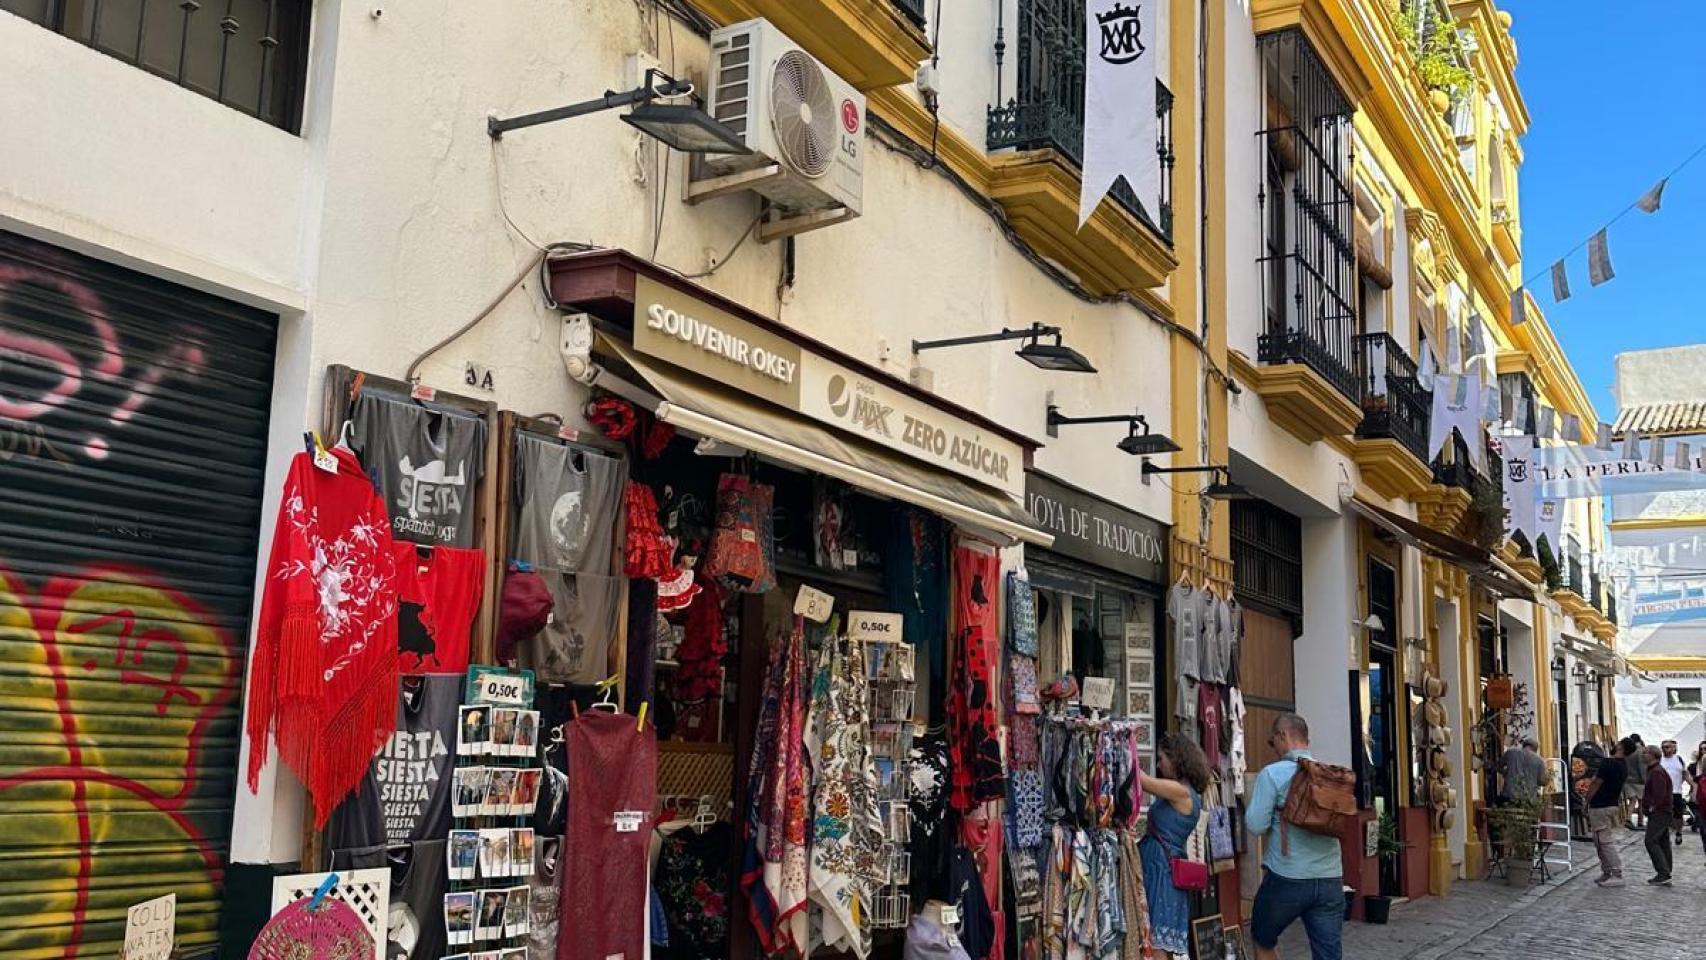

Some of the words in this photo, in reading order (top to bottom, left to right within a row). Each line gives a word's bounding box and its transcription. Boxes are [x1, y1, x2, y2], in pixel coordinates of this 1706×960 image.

[842, 134, 857, 158] LG
[647, 303, 749, 365] SOUVENIR
[752, 347, 796, 384] OKEY
[851, 393, 894, 438] MAX
[902, 415, 946, 456] ZERO
[950, 434, 1009, 482] AZÚCAR
[1070, 507, 1089, 540] DE
[1093, 516, 1163, 564] TRADICIÓN
[861, 621, 892, 632] 0,50€
[487, 682, 518, 698] 0,50€
[376, 759, 440, 783] SIESTA
[380, 784, 430, 802] SIESTA
[384, 802, 422, 816] SIESTA
[131, 900, 173, 927] COLD
